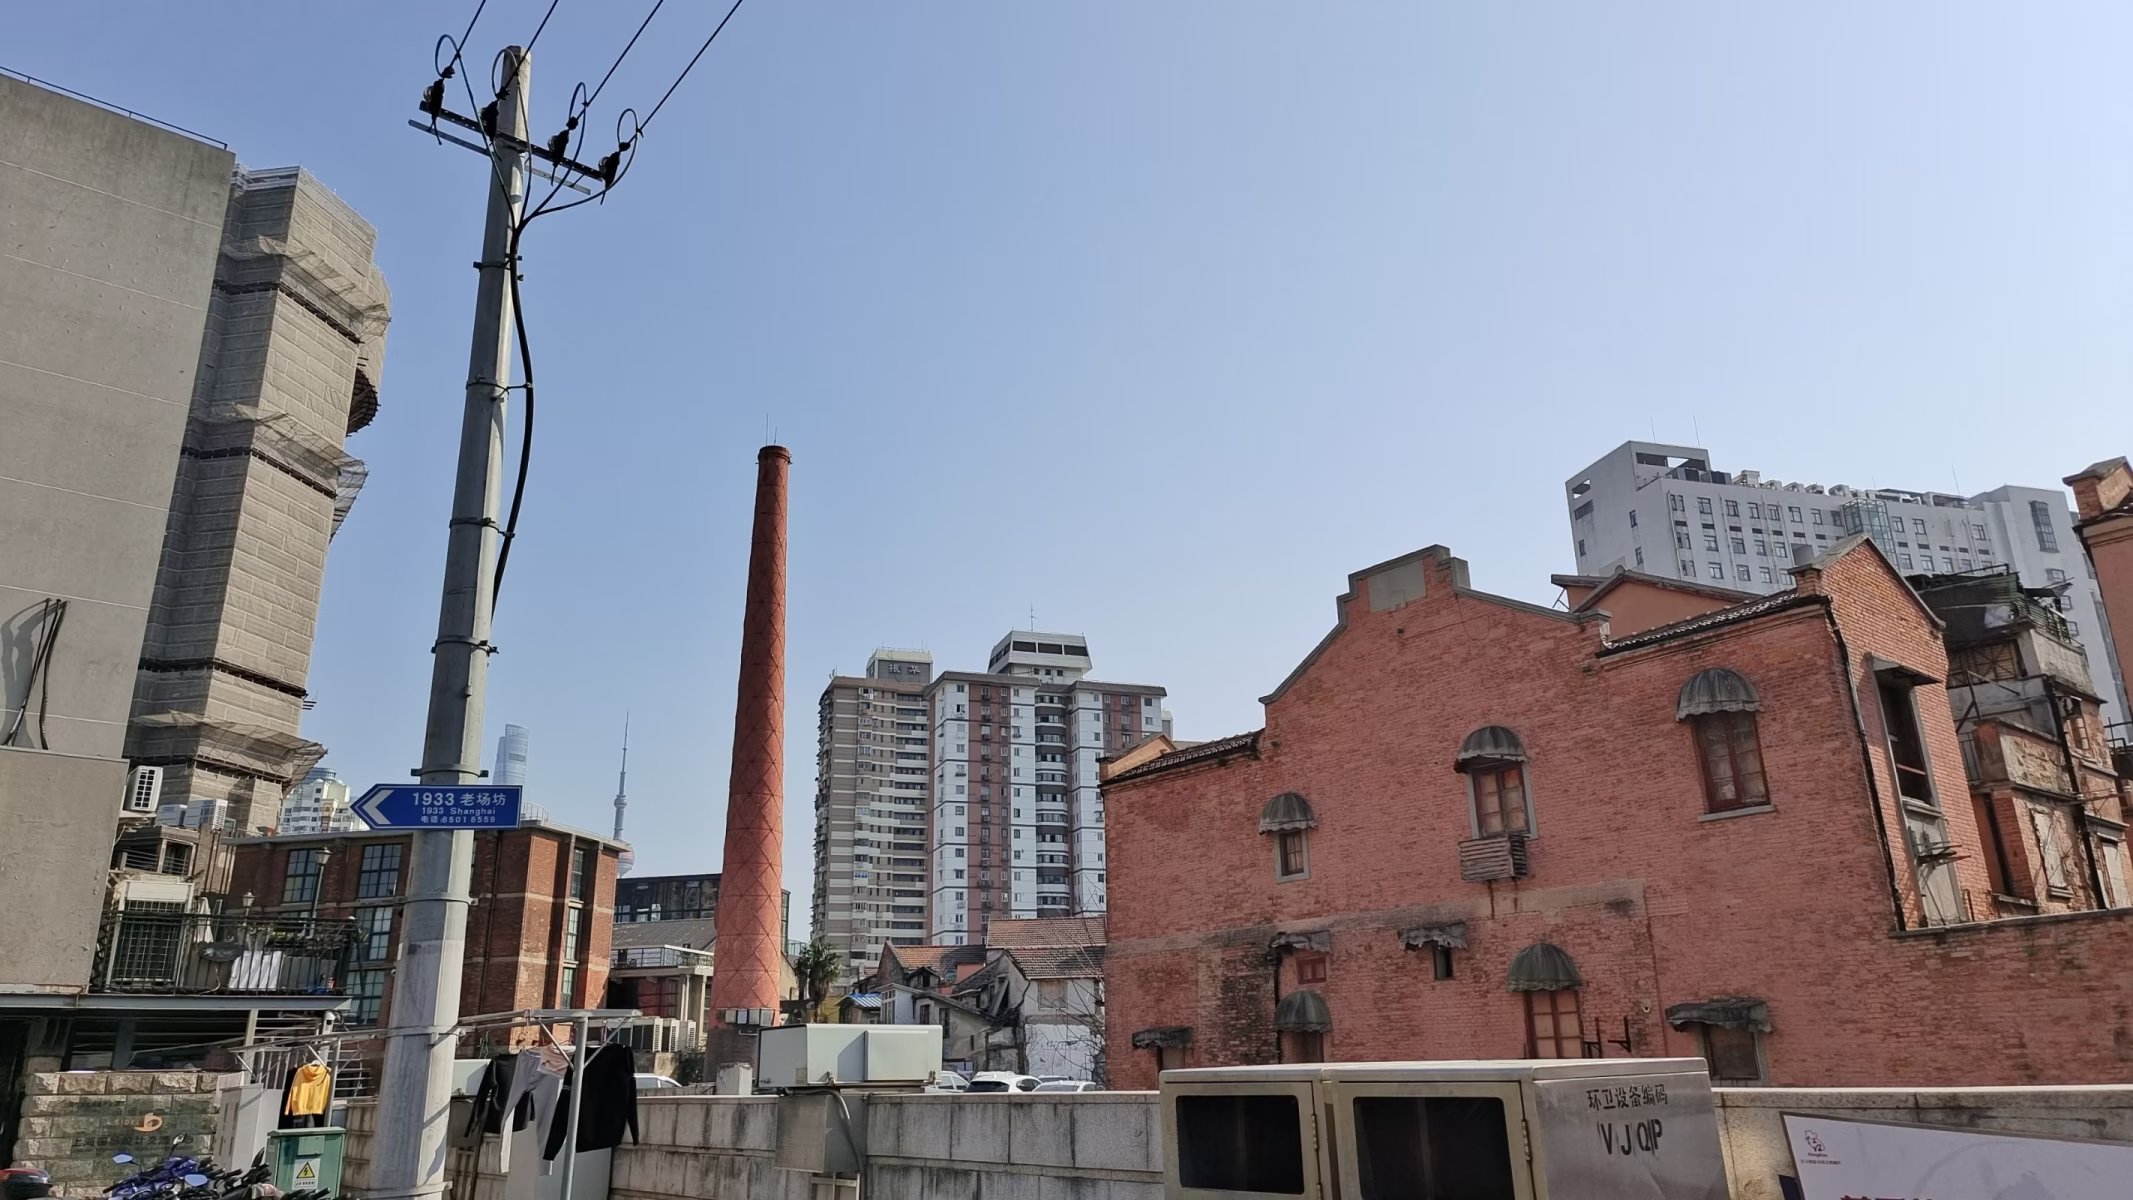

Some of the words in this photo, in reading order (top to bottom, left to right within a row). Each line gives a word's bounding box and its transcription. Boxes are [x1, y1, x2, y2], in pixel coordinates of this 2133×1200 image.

[412, 792, 455, 806] 1933
[460, 792, 507, 806] 老场坊
[422, 807, 445, 815] 1933
[450, 807, 496, 816] Shanghai
[1586, 1083, 1668, 1111] 环卫设备编码
